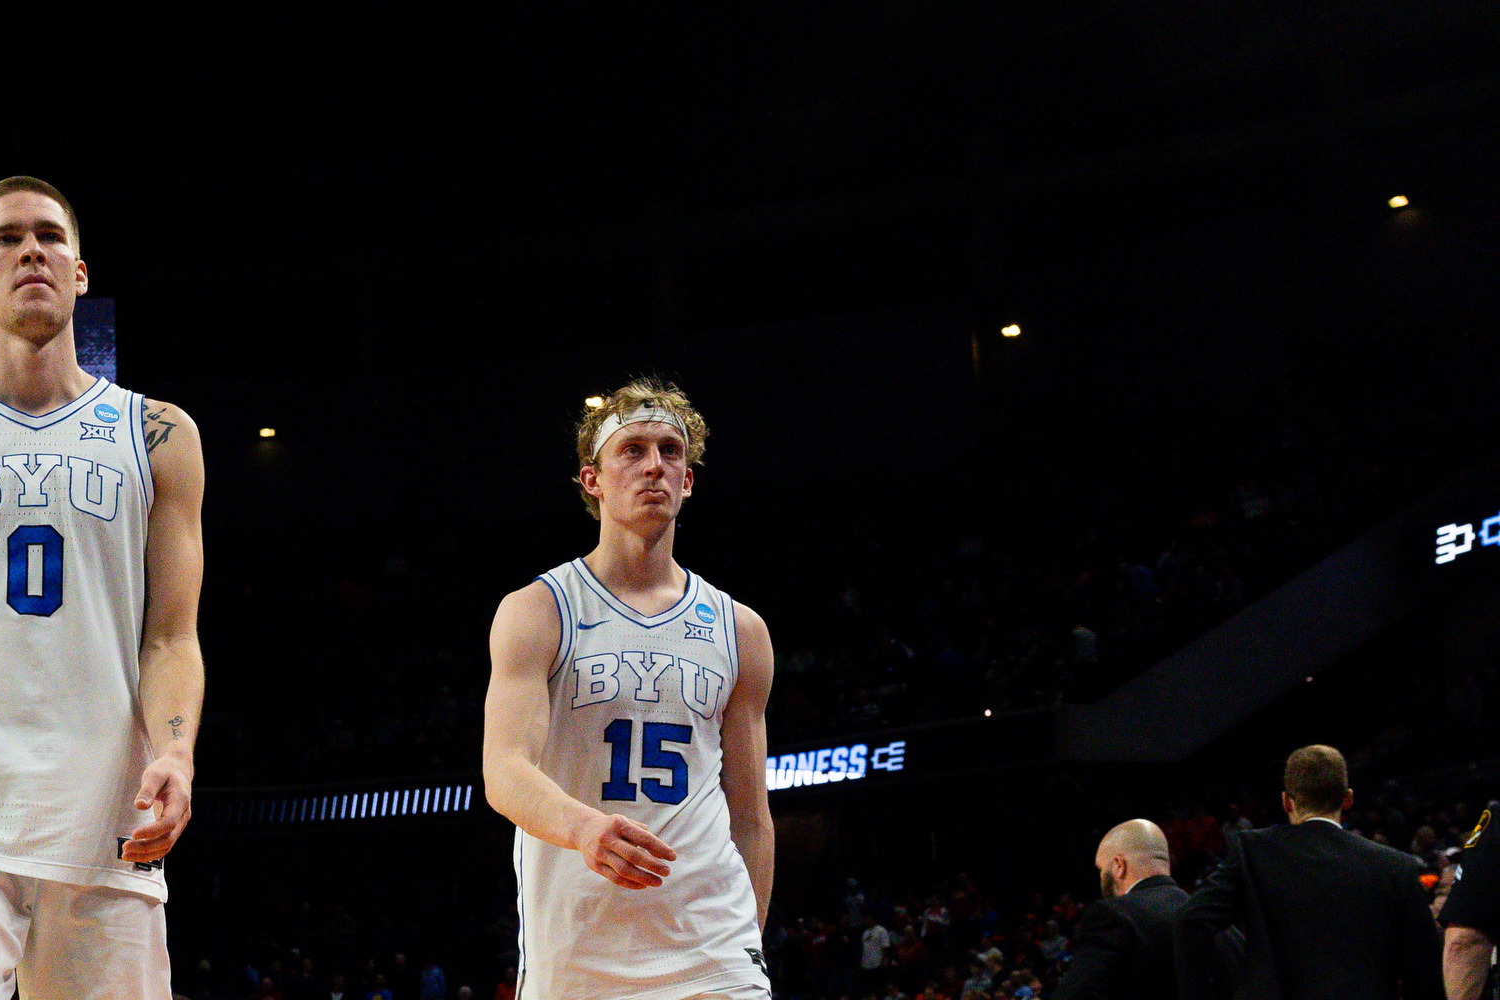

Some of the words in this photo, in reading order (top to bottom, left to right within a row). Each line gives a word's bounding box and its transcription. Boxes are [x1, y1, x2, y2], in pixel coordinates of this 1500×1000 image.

[6, 525, 64, 617] 0
[572, 651, 724, 720] BYU
[602, 719, 693, 805] 15
[766, 743, 868, 791] ADNESS
